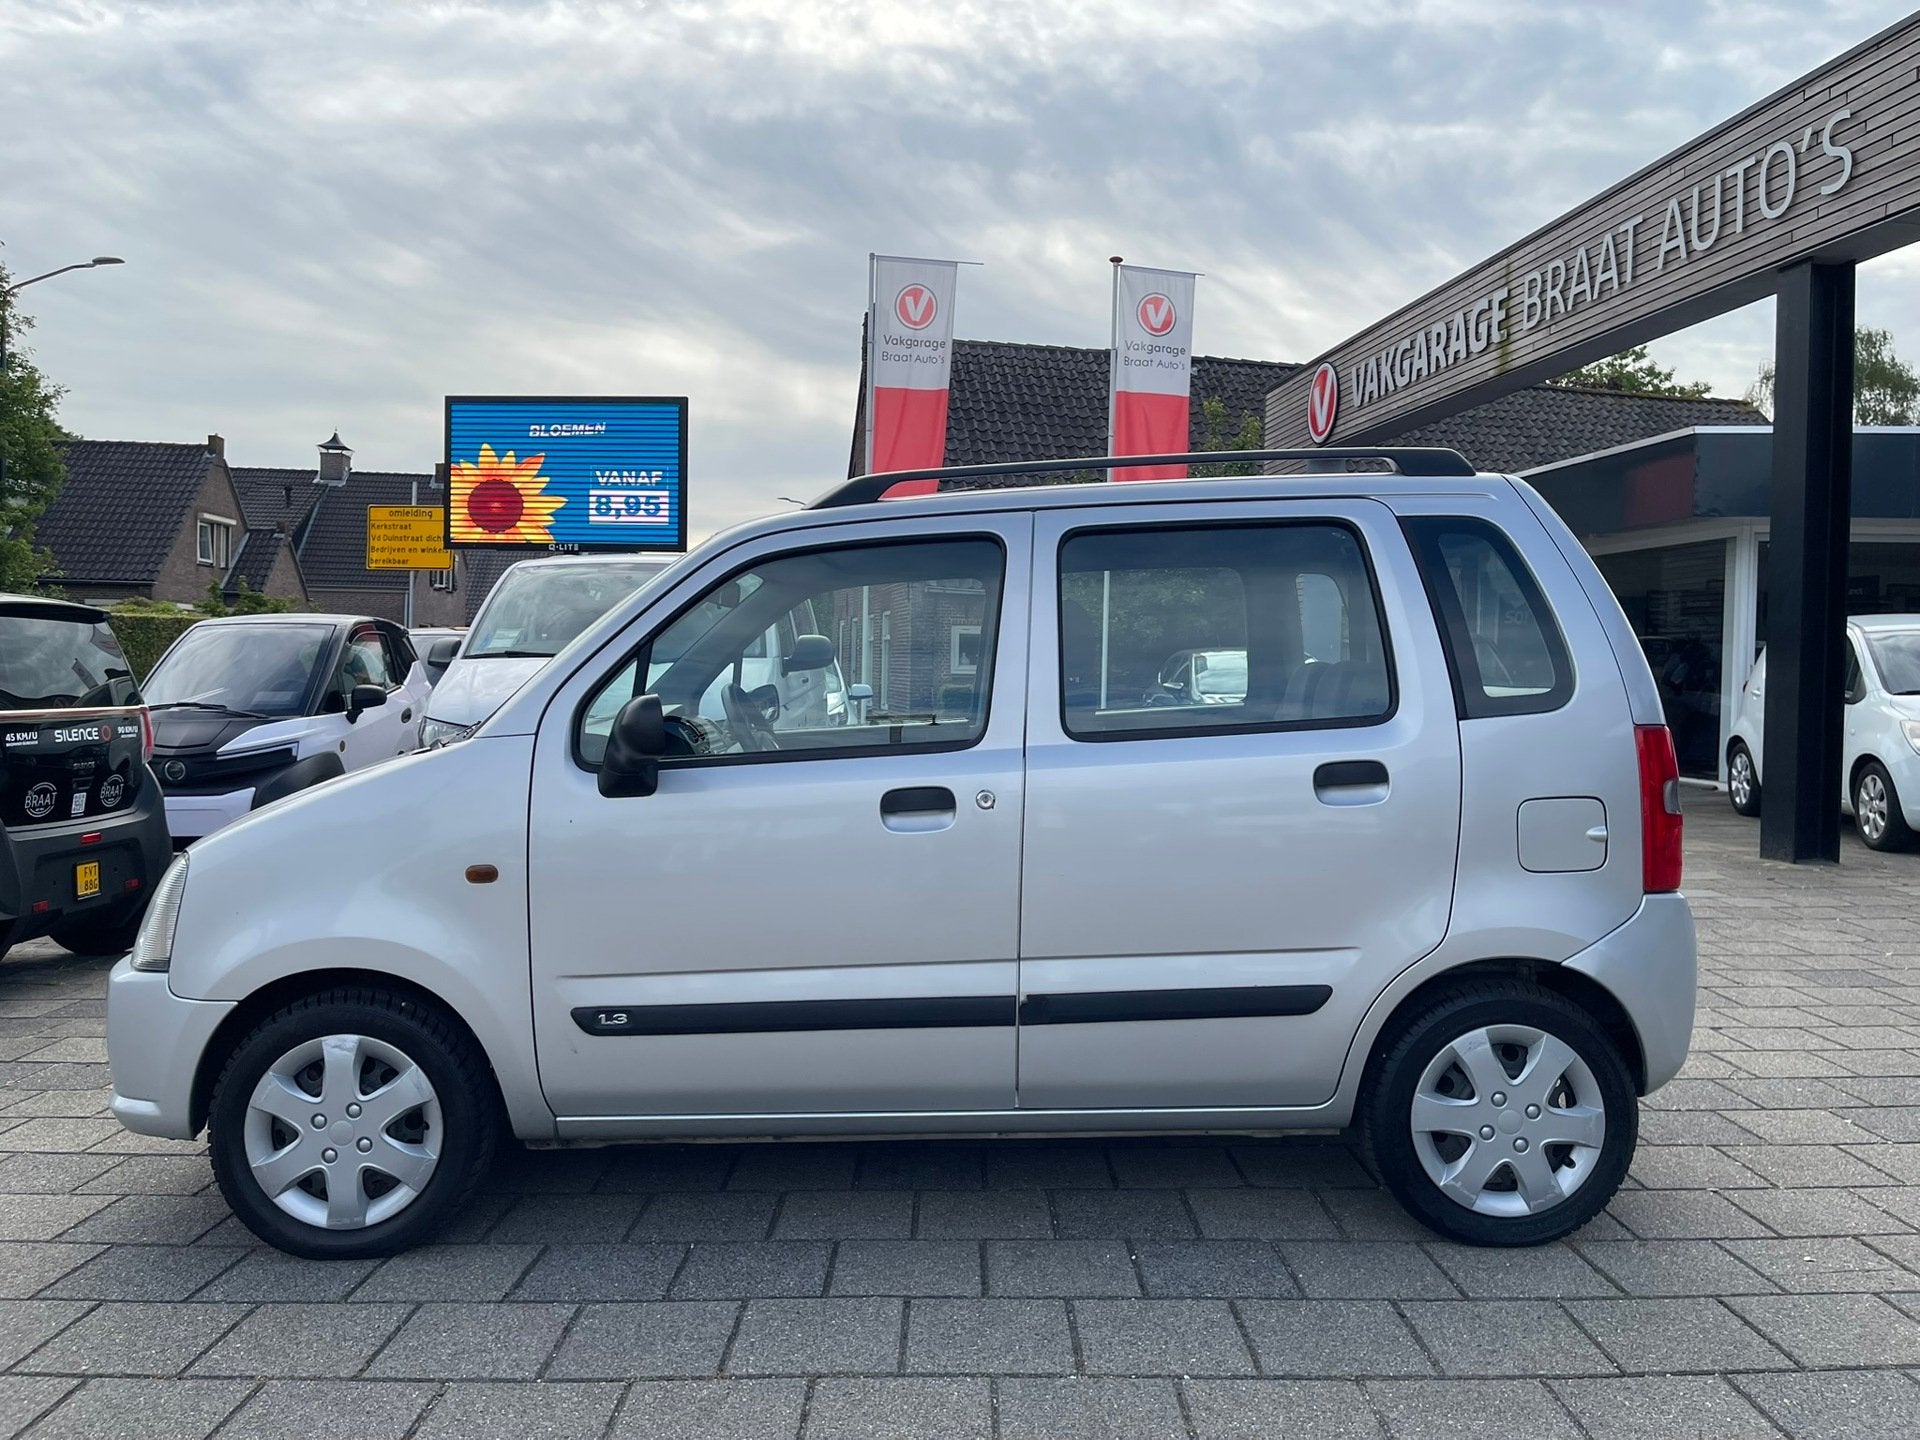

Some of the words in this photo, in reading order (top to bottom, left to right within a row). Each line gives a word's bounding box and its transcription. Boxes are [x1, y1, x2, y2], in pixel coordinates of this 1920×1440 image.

[1351, 287, 1508, 408] VAKGARAGE
[1522, 214, 1644, 331] BRAAT
[1656, 109, 1853, 271] AUTO'S
[883, 334, 946, 351] Vakgarage
[1124, 340, 1186, 357] Vakgarage
[881, 351, 912, 362] Braat
[914, 354, 945, 365] Auto's
[1124, 355, 1154, 367] Braat
[1156, 359, 1185, 370] Auto's
[529, 421, 607, 437] BLOEMEN
[595, 470, 663, 487] VANAF
[388, 509, 433, 520] omleiding
[594, 495, 661, 520] 8,95
[371, 523, 412, 531] Kerkstraat
[383, 534, 423, 542] Duinstraat
[425, 534, 444, 542] dich
[370, 545, 406, 555] Bedrijven
[420, 545, 449, 554] winke
[370, 557, 409, 565] bereikbaar
[5, 733, 16, 742] 45
[16, 731, 38, 741] KM/U
[54, 727, 99, 743] SILENCE
[100, 783, 125, 799] BRAAT
[25, 791, 58, 809] BRAAT
[84, 864, 98, 878] FVT
